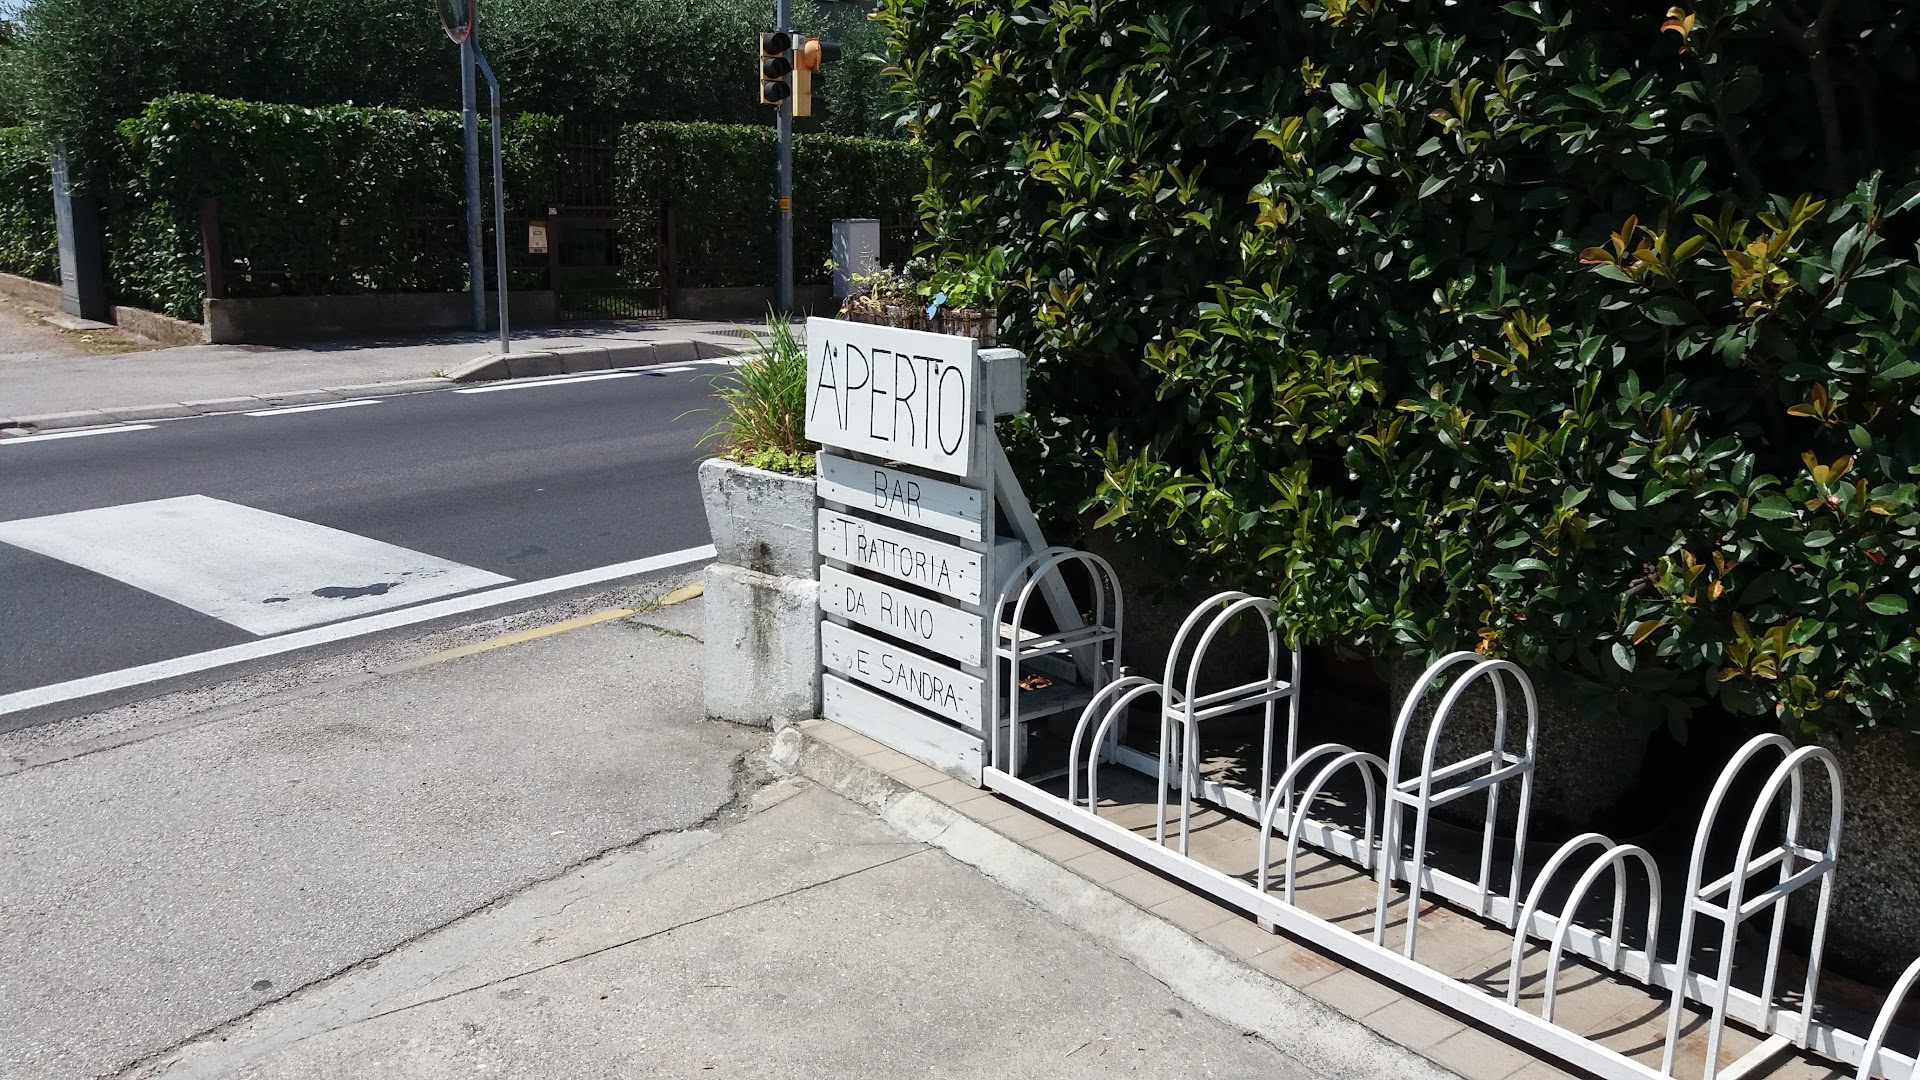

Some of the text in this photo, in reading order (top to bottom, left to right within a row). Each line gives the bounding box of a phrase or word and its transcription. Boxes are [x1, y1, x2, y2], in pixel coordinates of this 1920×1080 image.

[810, 339, 966, 456] APERTO
[874, 470, 921, 518] BAR
[836, 517, 952, 592] TRATTORIA
[846, 586, 934, 640] DA RINO
[857, 649, 959, 713] E SANDRA
